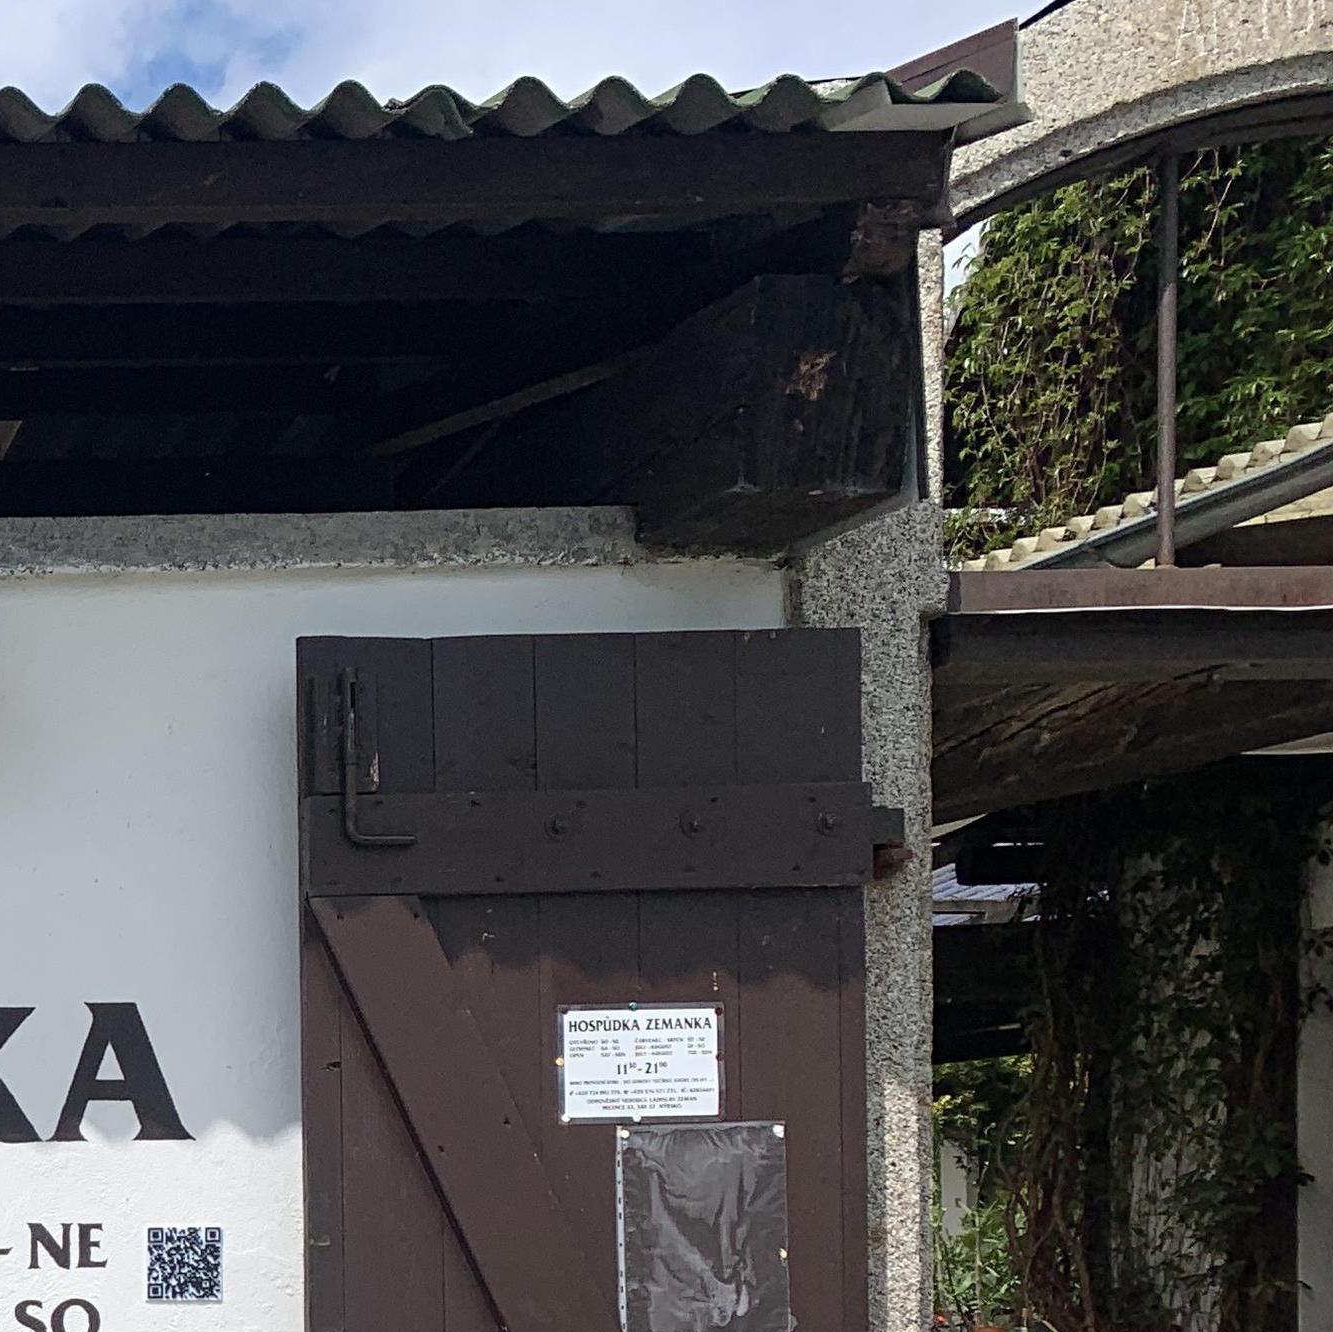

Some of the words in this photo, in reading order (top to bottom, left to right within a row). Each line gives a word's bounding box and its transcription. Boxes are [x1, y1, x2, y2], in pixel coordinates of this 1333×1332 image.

[568, 1015, 641, 1033] HOSPŮDKA
[645, 1017, 712, 1031] ZEMANKA
[25, 1221, 109, 1271] NE
